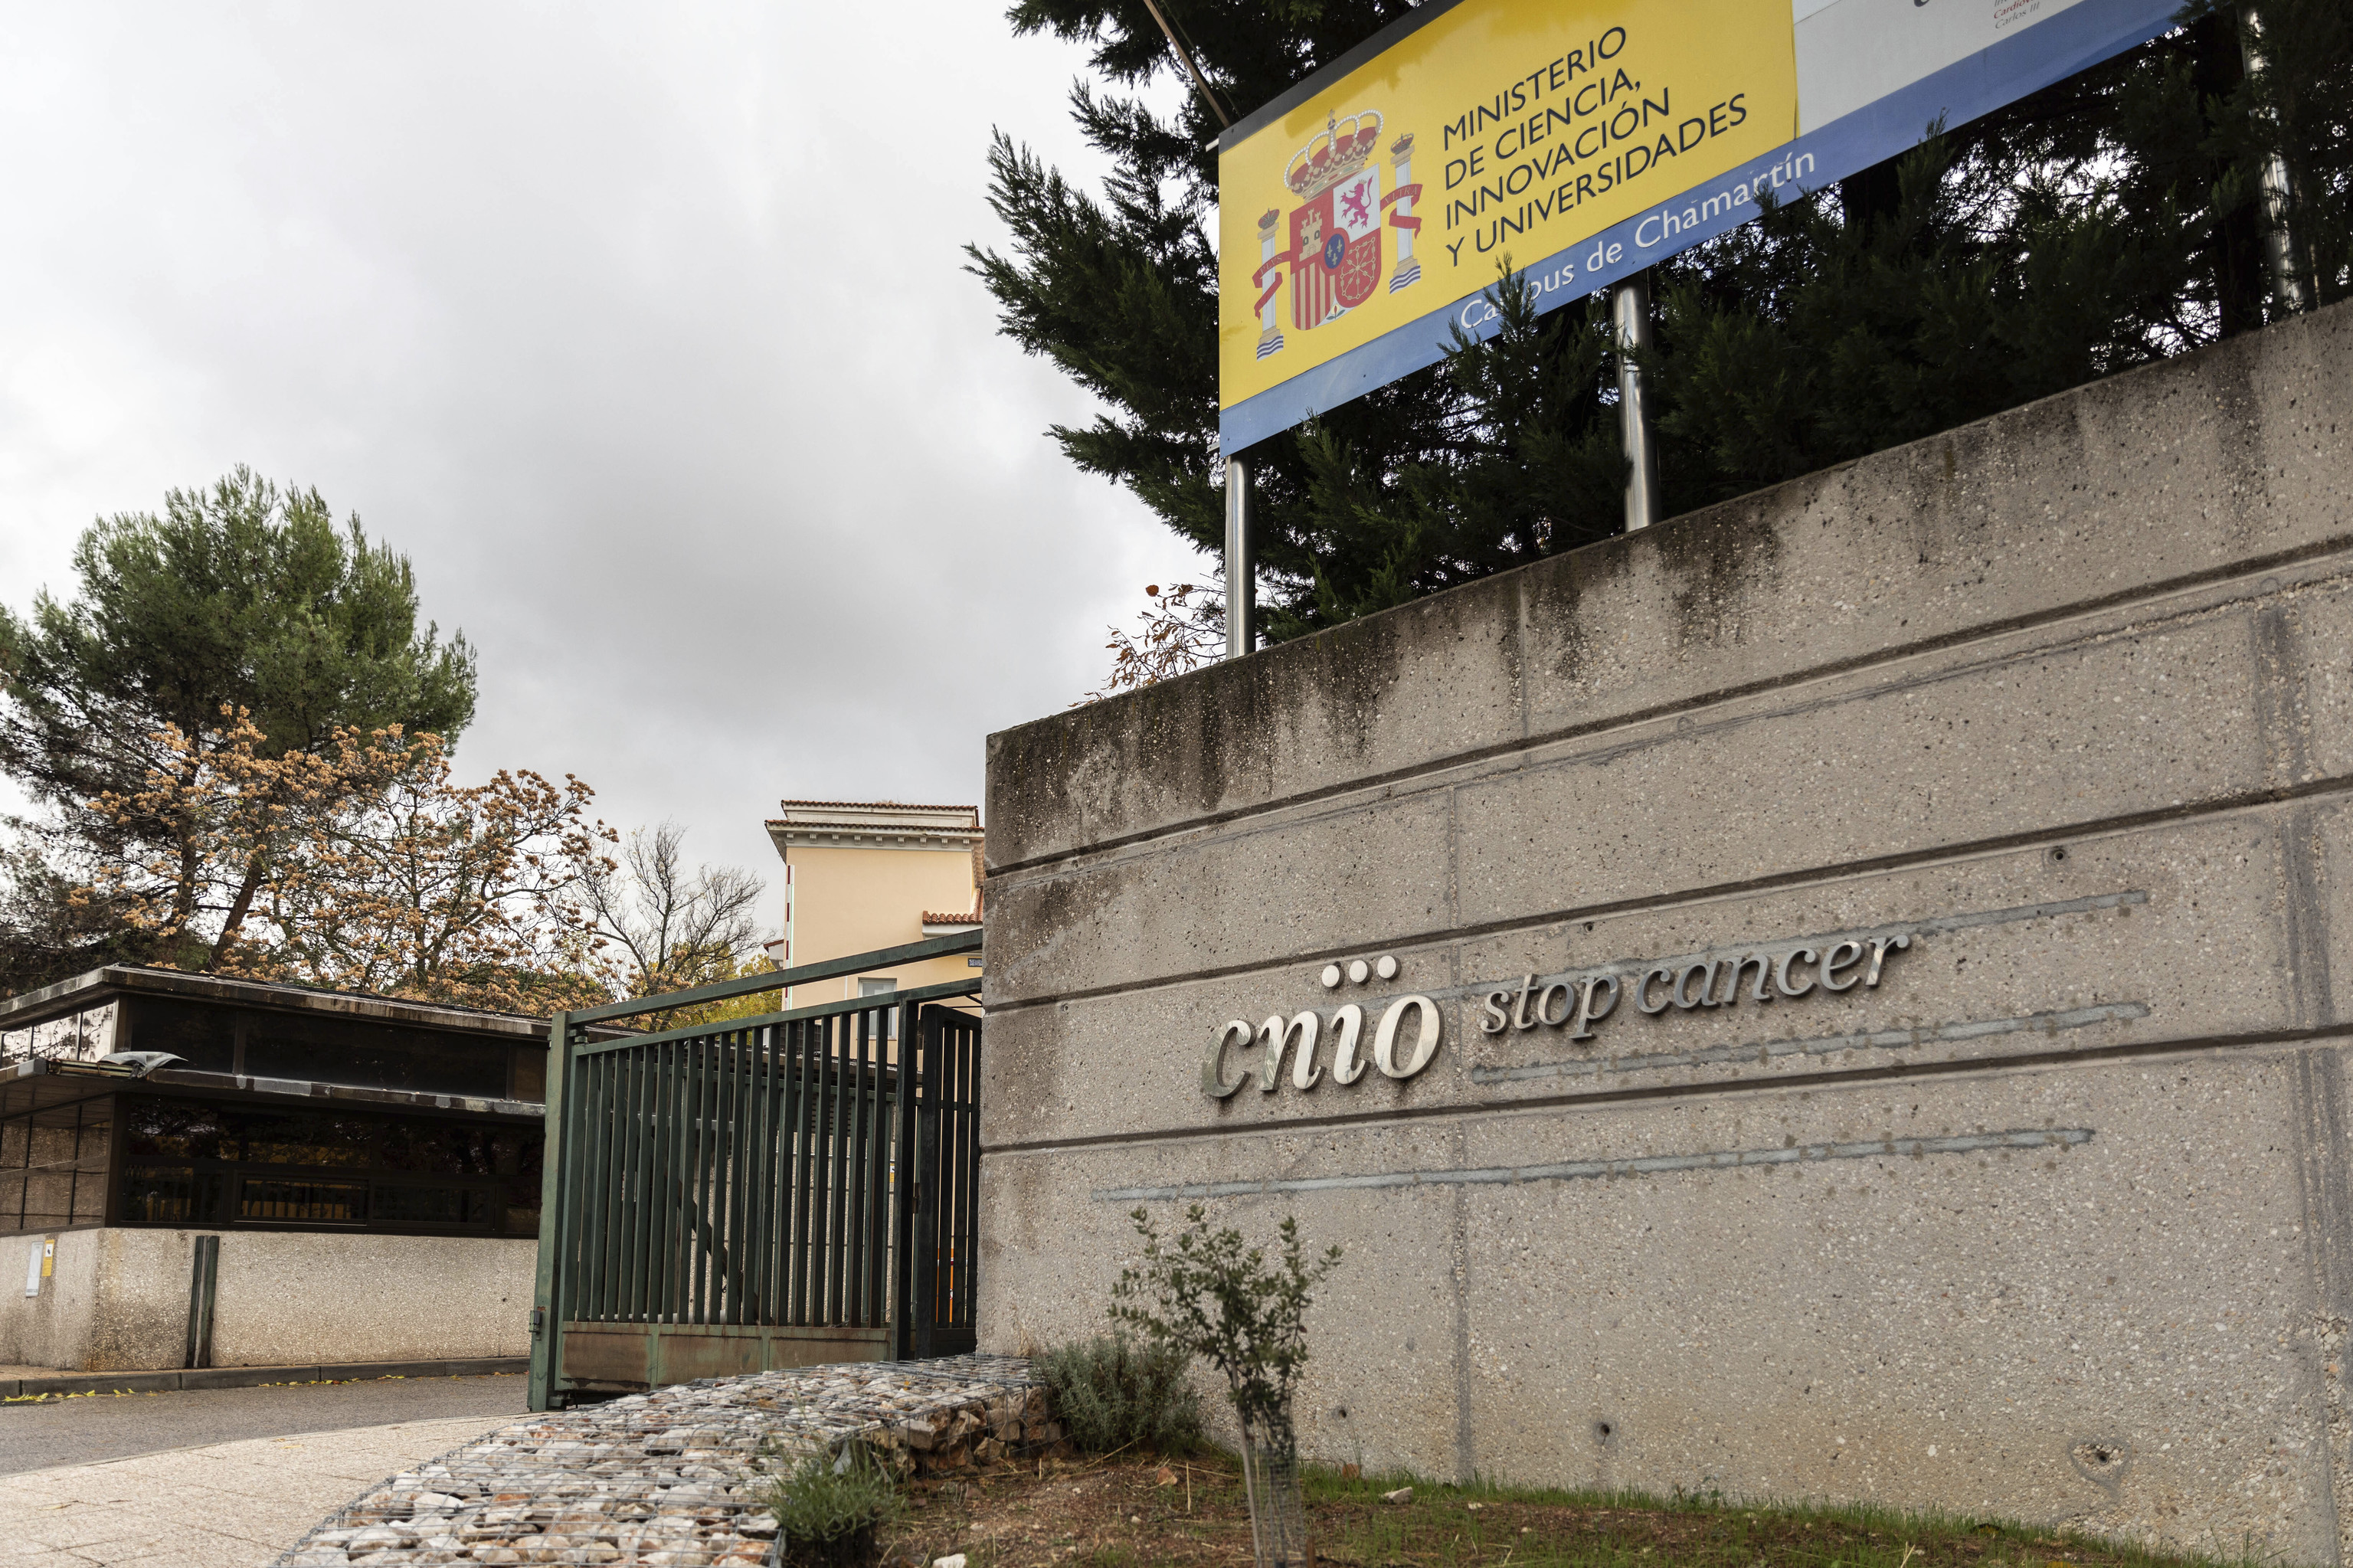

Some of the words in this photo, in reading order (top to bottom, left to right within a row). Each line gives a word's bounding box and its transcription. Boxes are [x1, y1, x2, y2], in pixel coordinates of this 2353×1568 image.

[1995, 11, 2027, 29] Carlos
[2030, 2, 2040, 14] III
[1443, 26, 1626, 152] MINISTERIO
[1445, 145, 1485, 191] DE
[1494, 67, 1641, 160] CIENCIA,
[1445, 236, 1466, 268] Y
[1475, 93, 1747, 252] UNIVERSIDADES
[1446, 87, 1670, 231] INNOVACIÓN
[1586, 241, 1623, 273] de
[1635, 152, 1815, 249] Chamartín
[1479, 973, 1623, 1040] stop
[1635, 934, 1912, 1016] cancer
